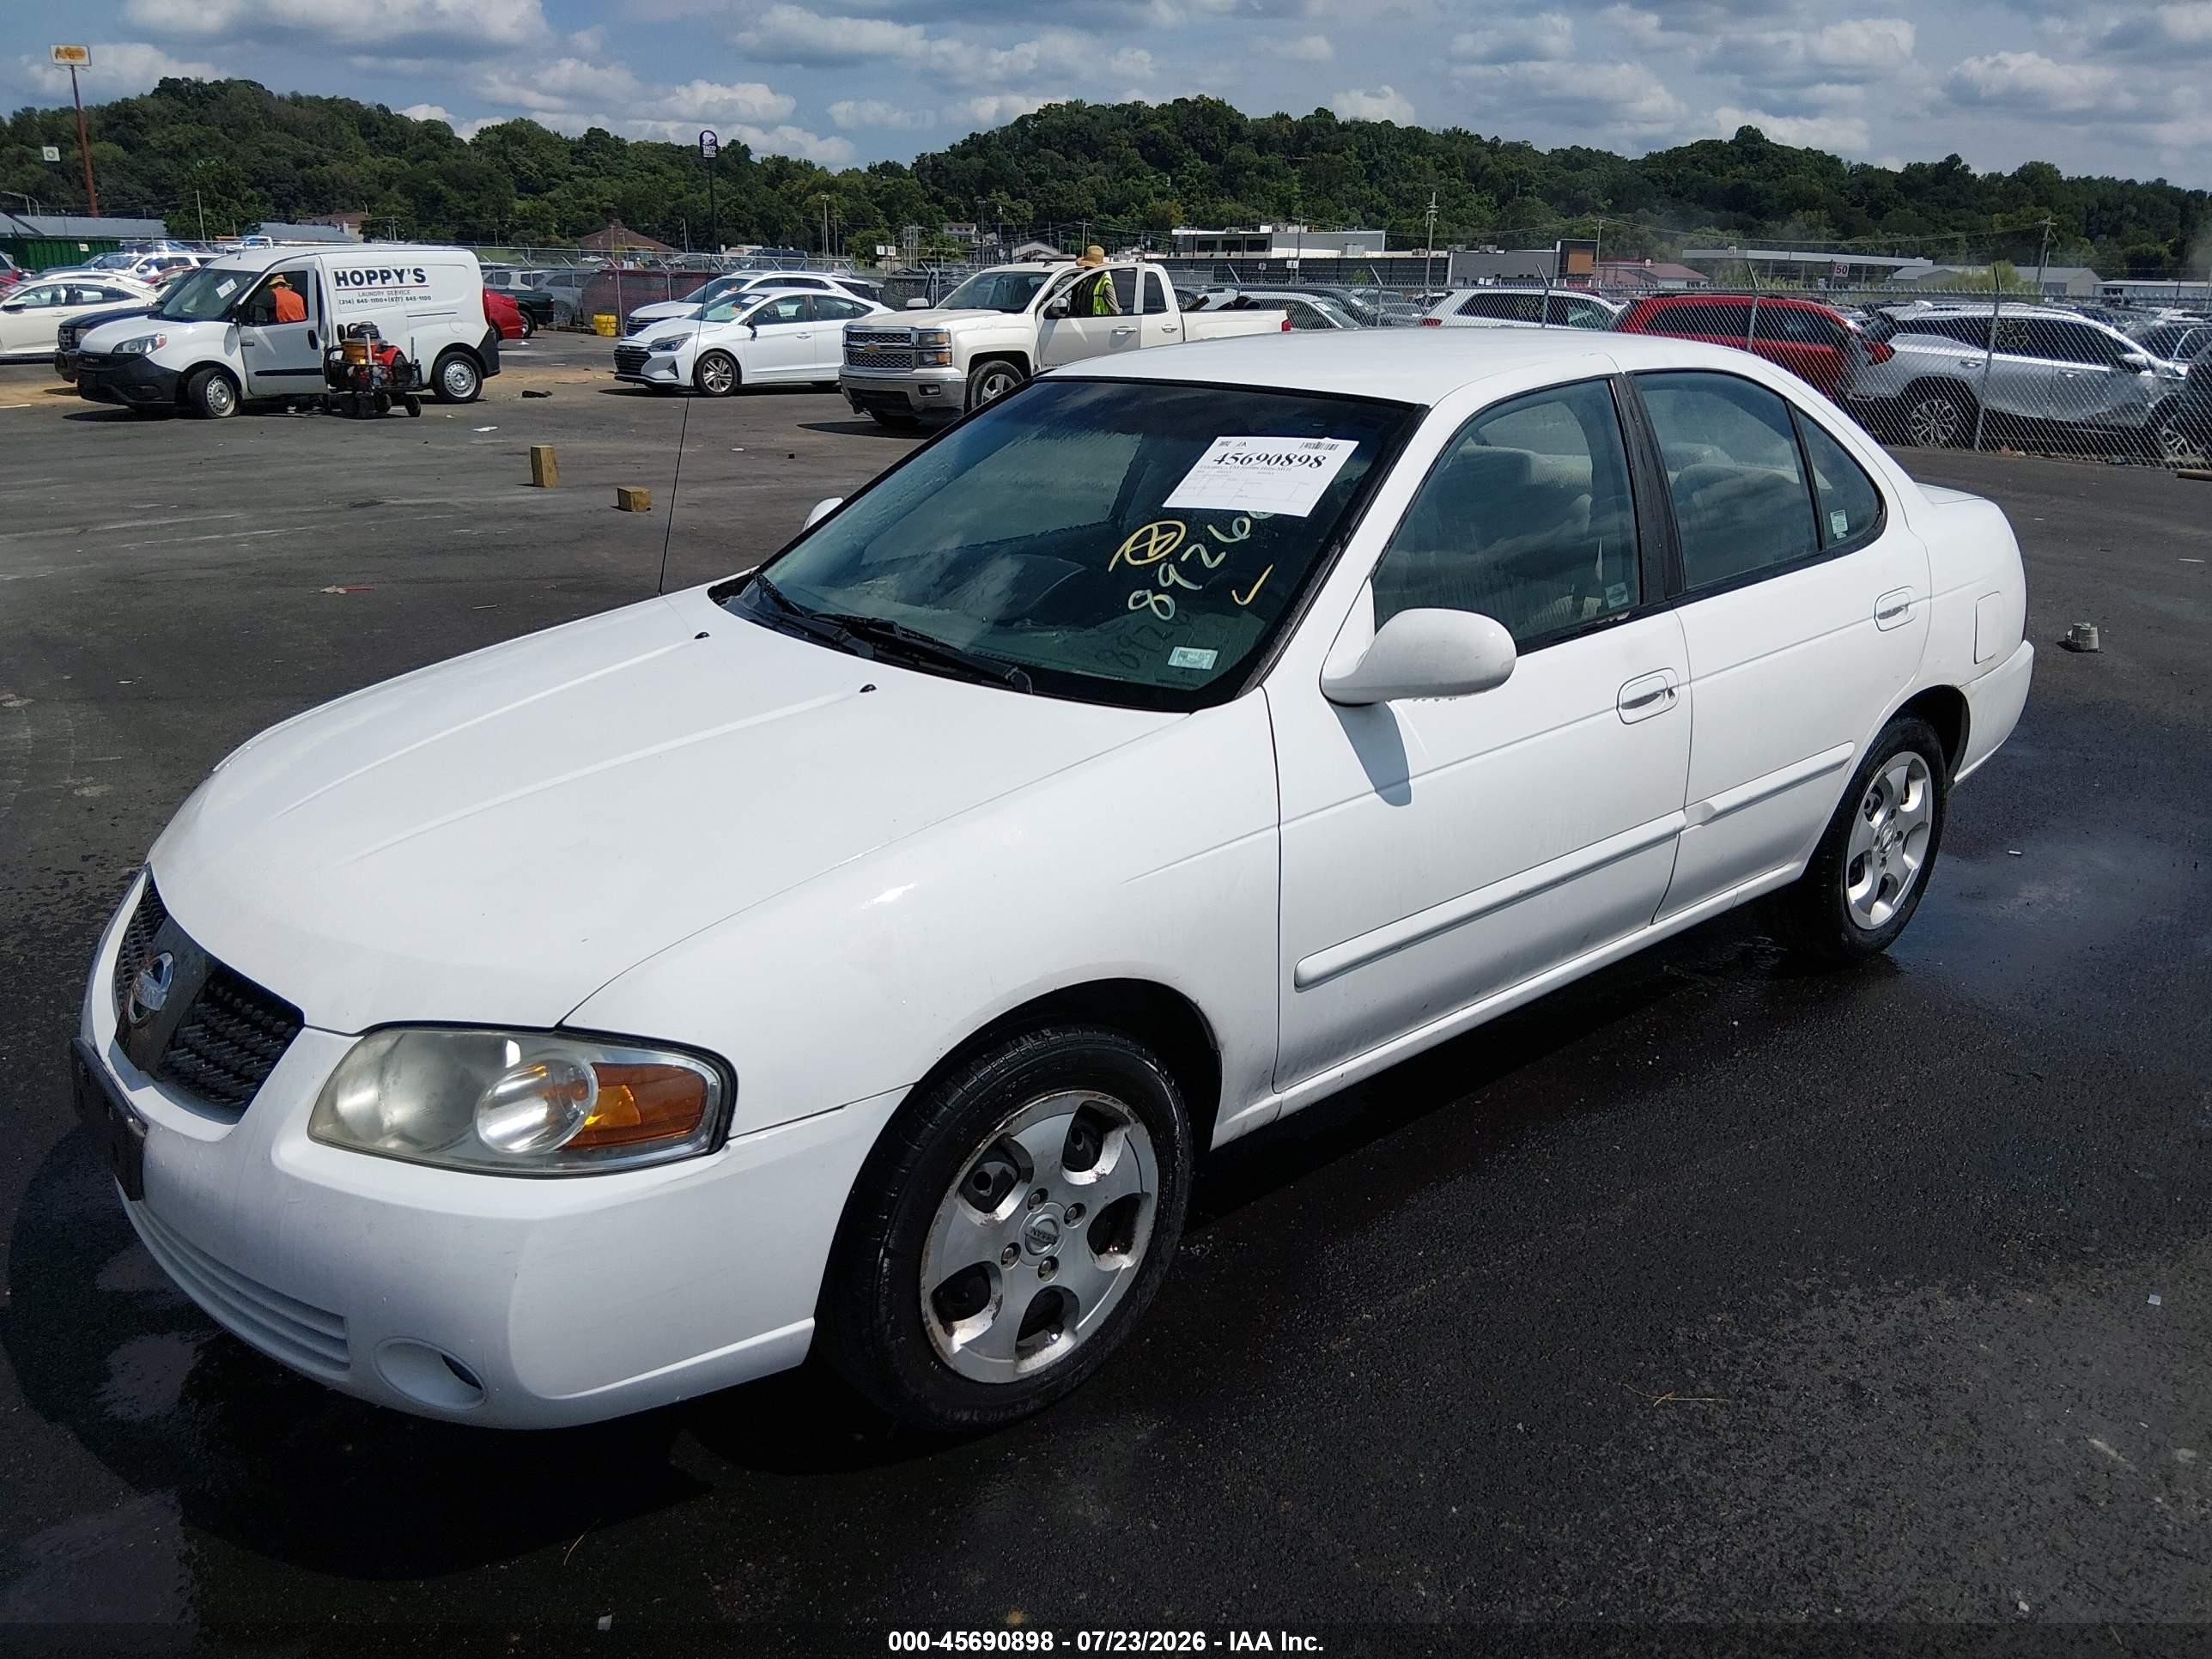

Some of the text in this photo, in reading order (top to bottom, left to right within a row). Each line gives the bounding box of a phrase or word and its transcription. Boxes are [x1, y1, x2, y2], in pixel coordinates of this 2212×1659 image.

[333, 267, 426, 286] HOPPY'S
[1836, 265, 1848, 274] 50
[1212, 452, 1327, 469] 45690898
[1127, 512, 1274, 620] 8926
